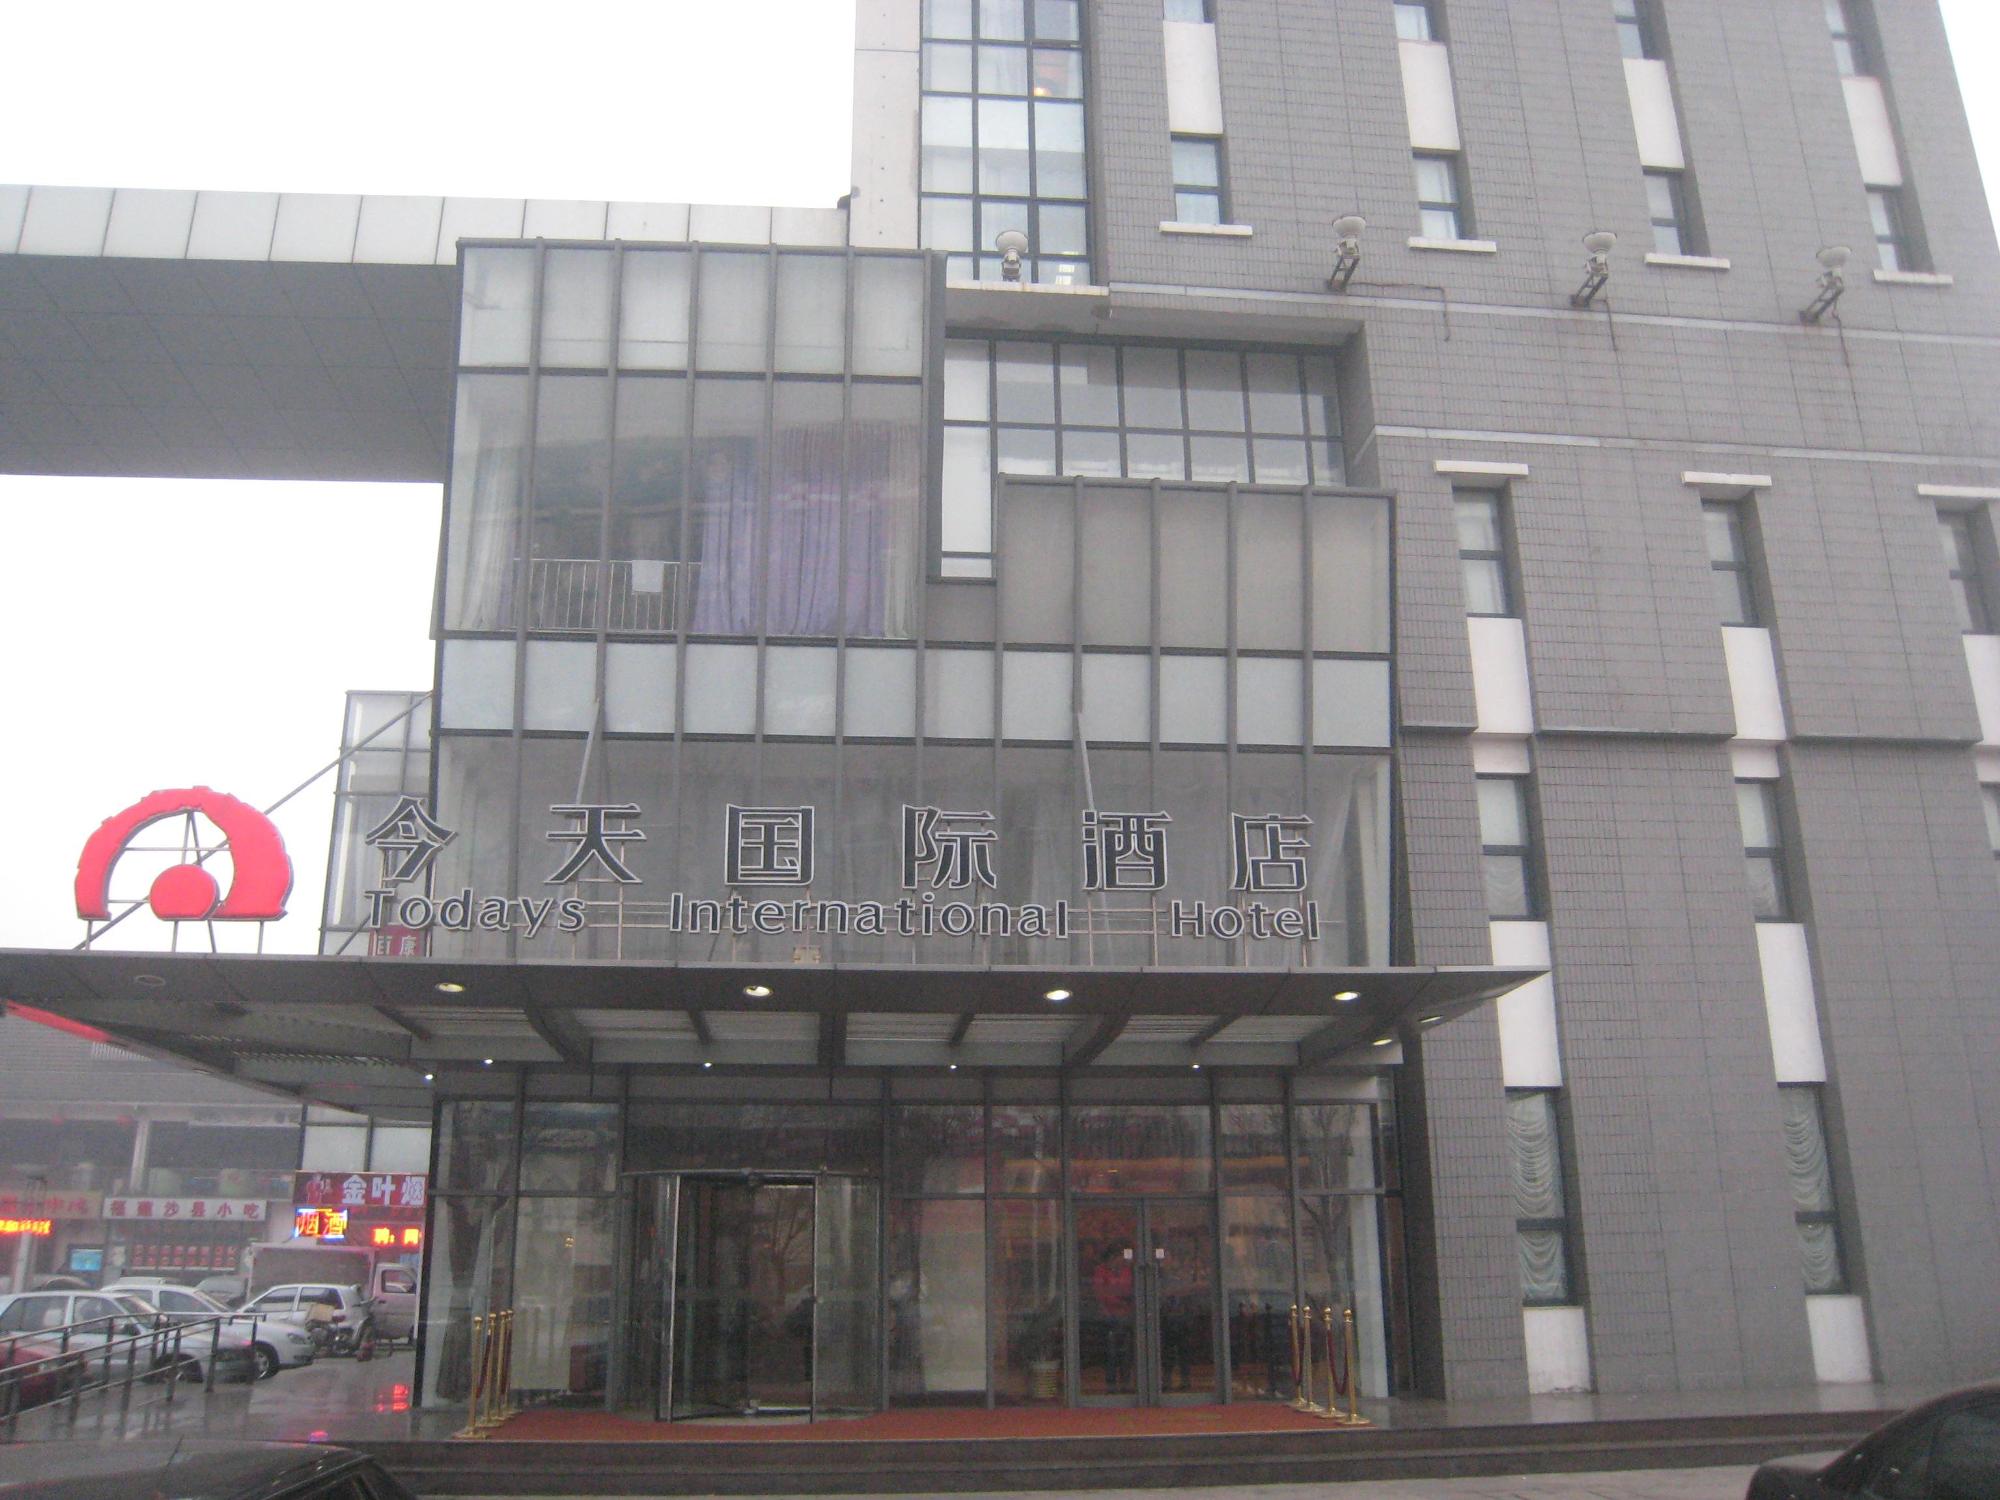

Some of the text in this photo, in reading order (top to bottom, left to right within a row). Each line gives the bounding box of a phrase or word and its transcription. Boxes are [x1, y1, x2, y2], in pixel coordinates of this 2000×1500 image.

[364, 796, 1314, 893] 今天国际酒店
[365, 887, 1321, 940] Todays International Hotel
[342, 1174, 426, 1207] 金叶烟
[296, 1211, 346, 1236] 烟酒
